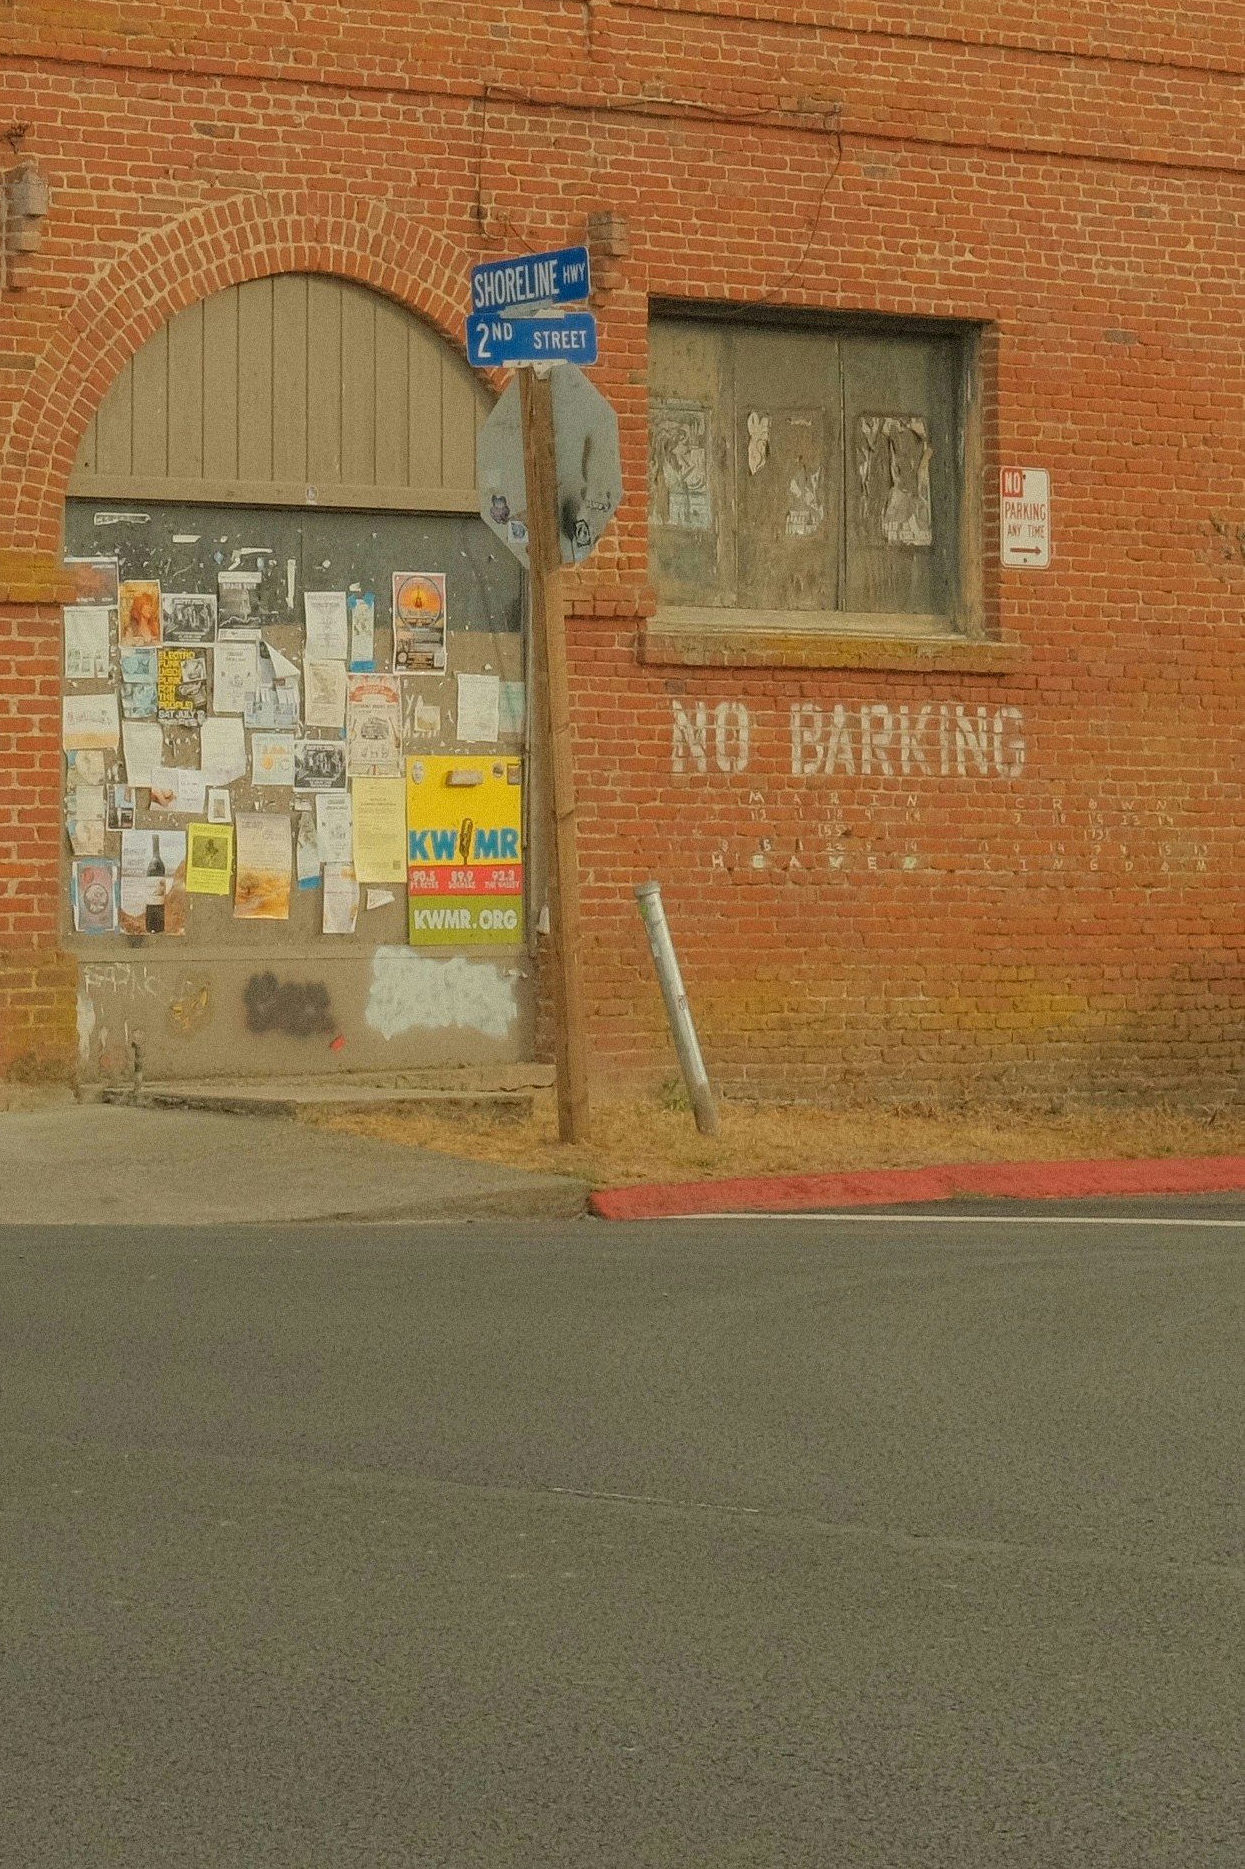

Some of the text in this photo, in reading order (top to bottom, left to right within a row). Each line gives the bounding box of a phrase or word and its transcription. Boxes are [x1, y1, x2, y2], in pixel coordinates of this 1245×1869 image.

[474, 259, 585, 308] SHORELINE HWY
[476, 323, 587, 358] 2ND STREET
[1004, 471, 1021, 493] NO
[1005, 502, 1046, 520] PARKING
[1007, 524, 1045, 538] ANY TIME
[158, 651, 195, 660] ELECTRO
[158, 710, 175, 718] SAT
[175, 710, 196, 718] JULY
[671, 700, 750, 775] NO
[451, 870, 474, 882] 89.9
[491, 870, 515, 882] 92.3
[414, 908, 518, 930] KWMR.ORG
